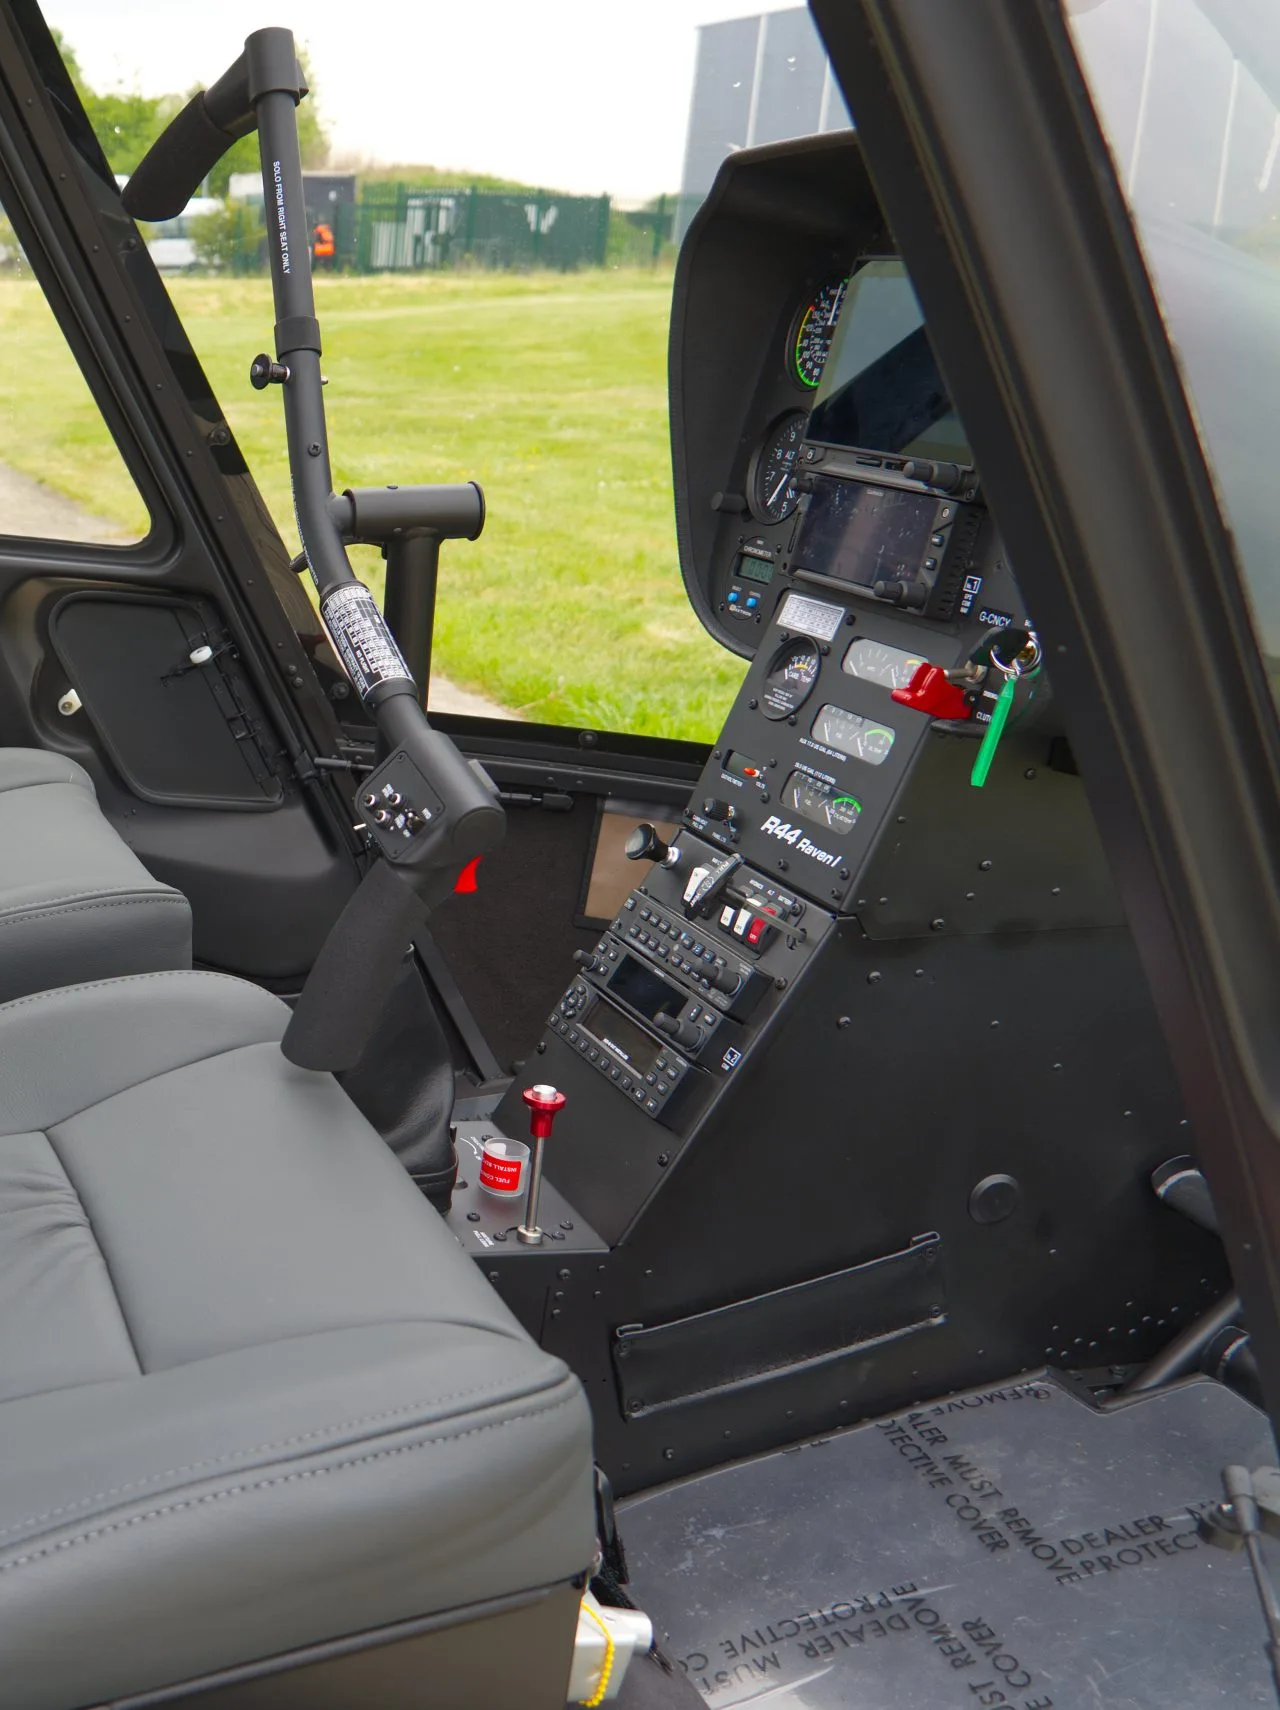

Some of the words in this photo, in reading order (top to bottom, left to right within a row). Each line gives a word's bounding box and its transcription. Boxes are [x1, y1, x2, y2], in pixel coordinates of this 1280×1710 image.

[272, 161, 281, 183] SOLO
[275, 184, 283, 206] FROM
[277, 207, 286, 230] RIGHT
[279, 231, 289, 252] SEAT
[281, 253, 291, 274] ONLY
[789, 431, 796, 442] 9
[776, 449, 782, 459] 8
[785, 451, 795, 460] ALT
[769, 471, 776, 481] 7
[781, 501, 788, 512] 5
[979, 610, 1012, 628] G-CNCY
[360, 657, 371, 674] FLIGHT
[975, 711, 992, 722] CLUT
[760, 815, 802, 845] R44
[796, 838, 833, 866] Raven
[493, 1163, 518, 1172] INSTALL
[495, 1176, 511, 1184] FUEL
[943, 1453, 1003, 1499] MUST
[999, 1507, 1082, 1586] REMOVE
[945, 1493, 1011, 1553] COVER
[1060, 1515, 1173, 1556] DEALER
[719, 1590, 894, 1660] PROTECTIVE
[797, 1612, 911, 1660] DEALER
[892, 1582, 977, 1670] REMOVE
[961, 1616, 1032, 1689] COVER
[699, 1651, 782, 1696] MUST
